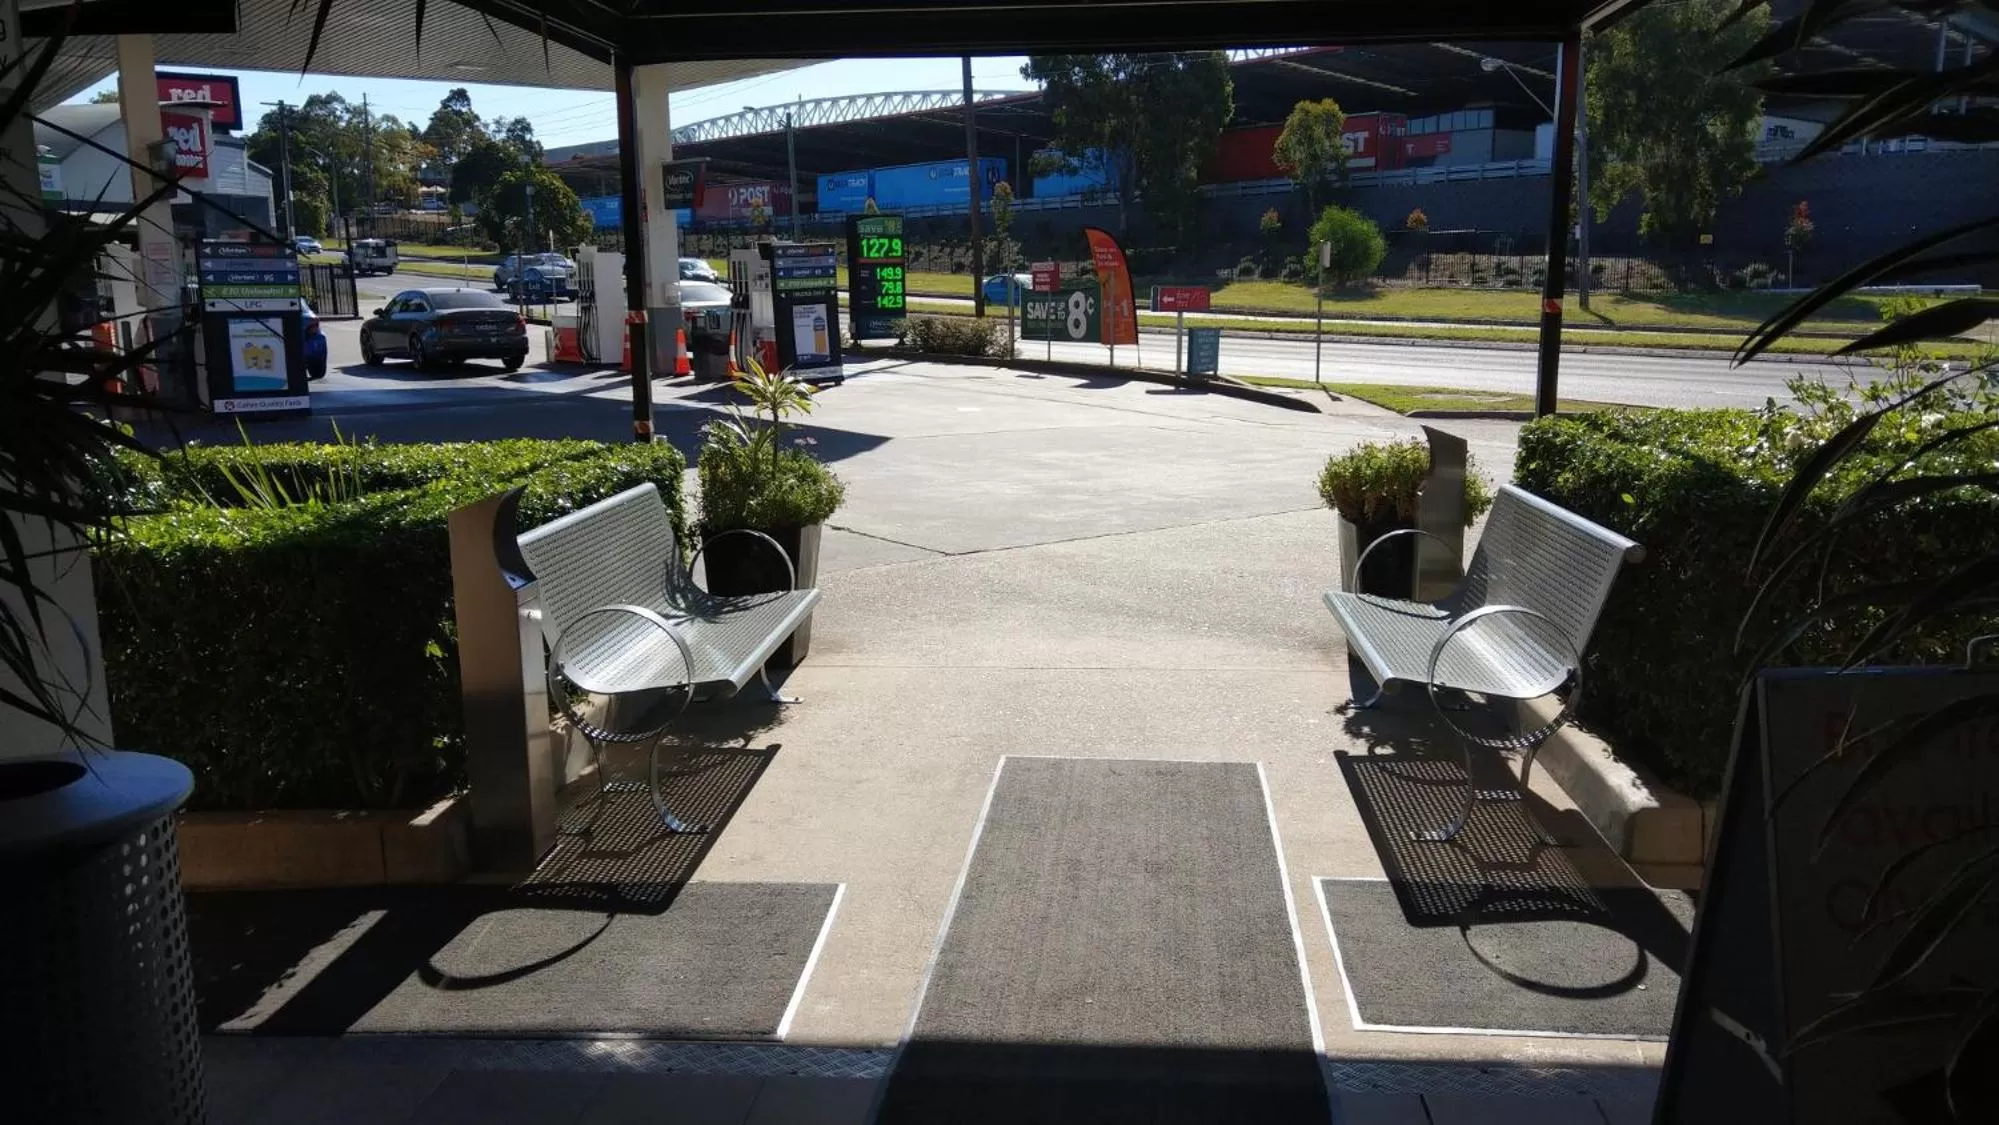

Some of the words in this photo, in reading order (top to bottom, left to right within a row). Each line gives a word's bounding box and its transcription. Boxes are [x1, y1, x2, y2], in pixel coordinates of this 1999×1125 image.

[169, 85, 211, 102] red
[167, 122, 202, 152] red
[1342, 131, 1369, 153] ST
[739, 186, 770, 205] POST
[861, 238, 902, 257] 127.9
[876, 267, 903, 280] 149.9
[877, 295, 903, 309] 142.9
[1027, 302, 1056, 320] SAVE
